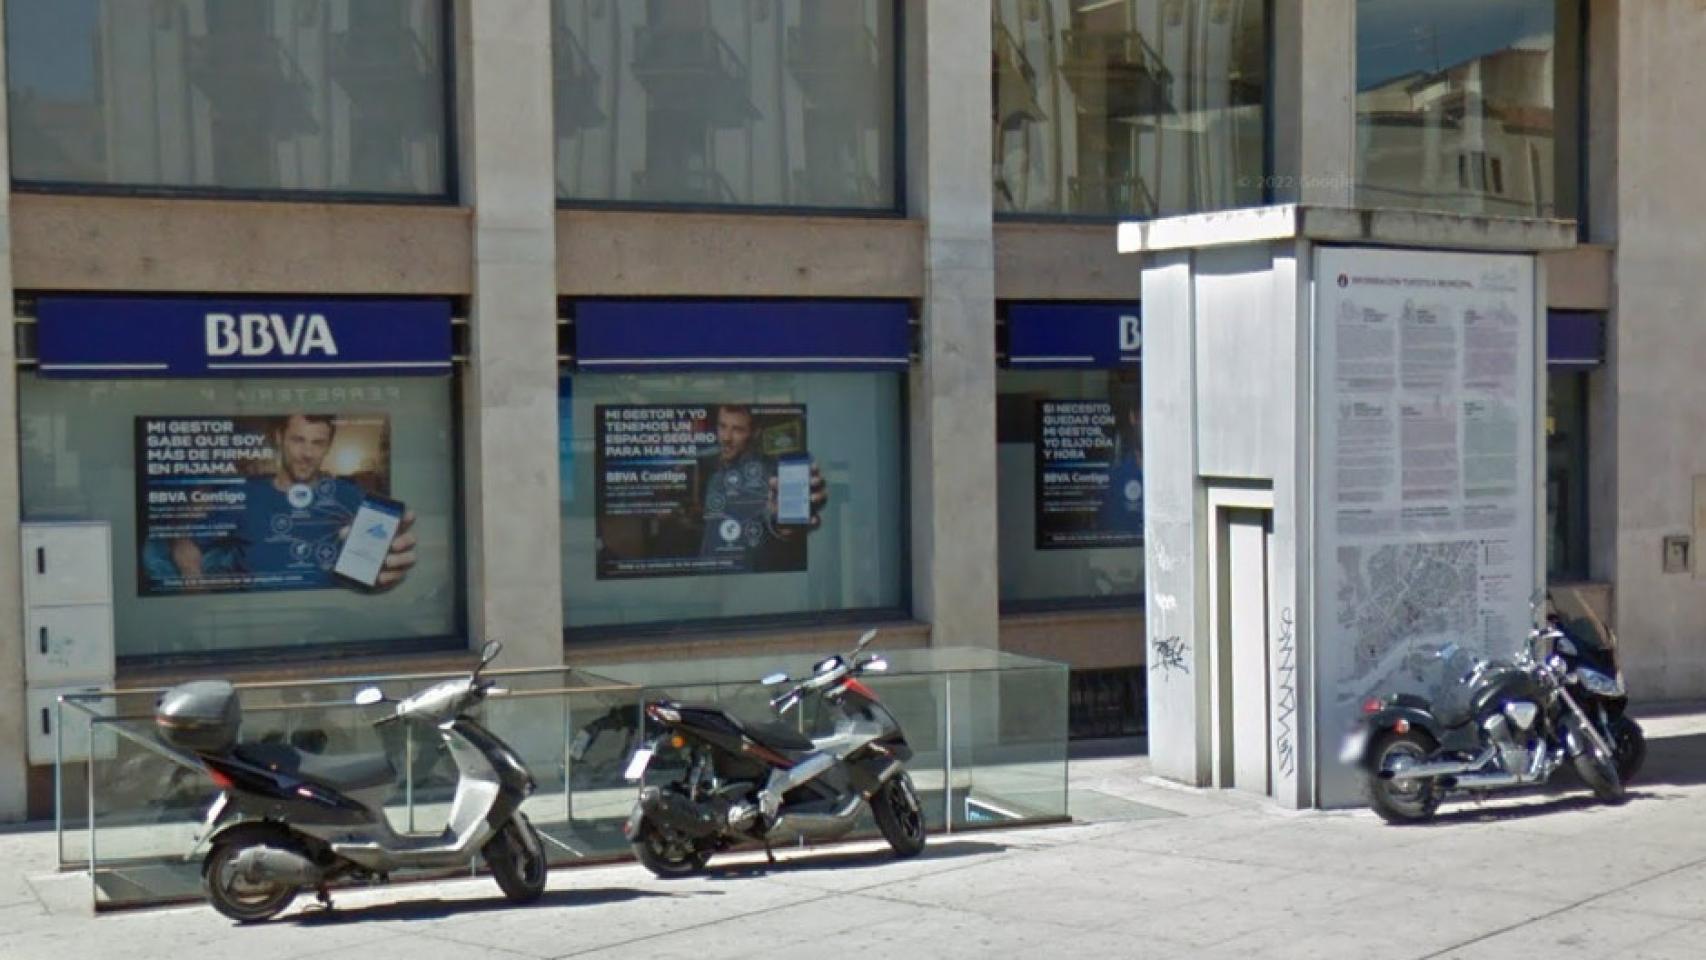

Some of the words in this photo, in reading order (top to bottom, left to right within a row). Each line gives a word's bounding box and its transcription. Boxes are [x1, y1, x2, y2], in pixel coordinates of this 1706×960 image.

[205, 314, 338, 355] BBVA
[606, 408, 621, 419] MI
[623, 408, 674, 419] GESTOR
[677, 408, 686, 418] Y
[689, 408, 707, 419] YO
[1043, 403, 1055, 413] SI
[1056, 403, 1111, 413] NECESITO
[1043, 415, 1089, 425] QUEDAR
[1091, 415, 1116, 424] CON
[147, 421, 165, 433] MI
[169, 421, 234, 433] GESTOR
[606, 421, 669, 431] TENEMOS
[671, 421, 691, 431] UN
[1043, 427, 1057, 436] MI
[147, 435, 192, 447] SABE
[195, 435, 230, 447] QUE
[232, 434, 265, 447] SOY
[606, 433, 661, 443] ESPACIO
[663, 432, 716, 442] SEGURO
[1044, 438, 1060, 447] YO
[1062, 438, 1093, 447] ELIJO
[148, 447, 185, 460] MÁS
[188, 449, 209, 460] DE
[212, 448, 274, 459] FIRMAR
[606, 446, 641, 456] PARA
[644, 445, 697, 456] HABLAR
[1044, 450, 1052, 459] Y
[1054, 449, 1086, 459] HORA
[148, 463, 170, 474] EN
[173, 462, 238, 474] PIJAMA
[606, 472, 638, 482] BBVA
[640, 471, 687, 483] Contigo
[1044, 473, 1070, 483] BBVA
[1071, 473, 1111, 484] Contigo
[149, 491, 187, 502] BBVA
[191, 491, 247, 504] Contigo
